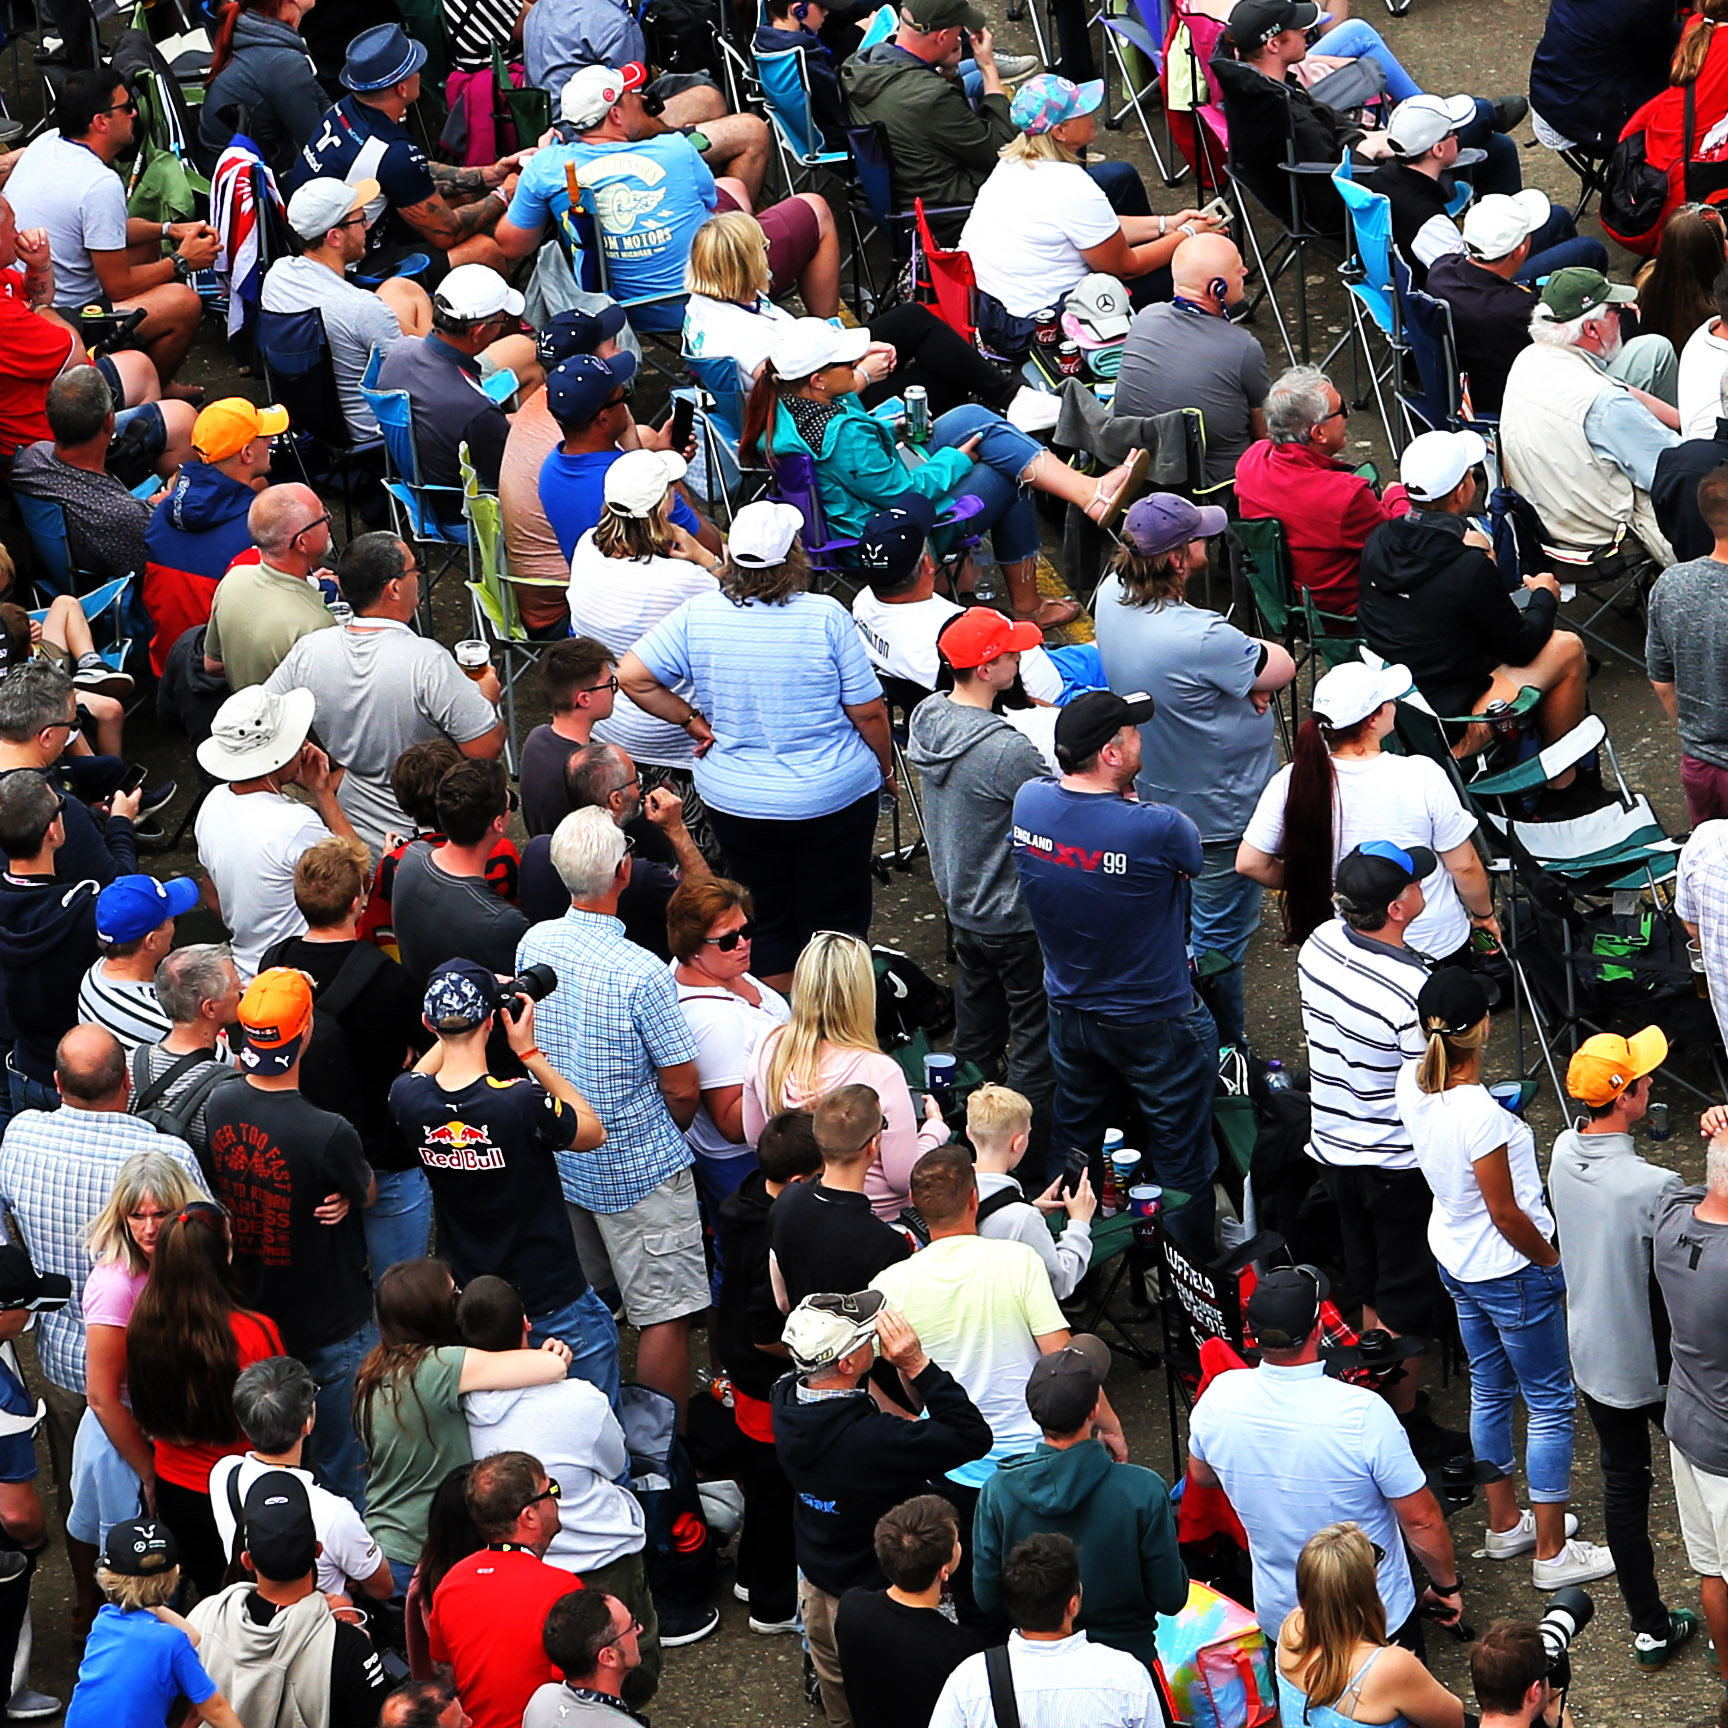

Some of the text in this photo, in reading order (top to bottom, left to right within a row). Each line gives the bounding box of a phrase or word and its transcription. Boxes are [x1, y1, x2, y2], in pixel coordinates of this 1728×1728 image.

[622, 227, 673, 250] MOTORS
[1013, 825, 1054, 853] ENGLAND
[239, 1122, 270, 1151] TOO
[265, 1146, 292, 1192] FAST
[418, 1147, 506, 1170] Red Bull
[1164, 1240, 1216, 1300] LUFFIELD
